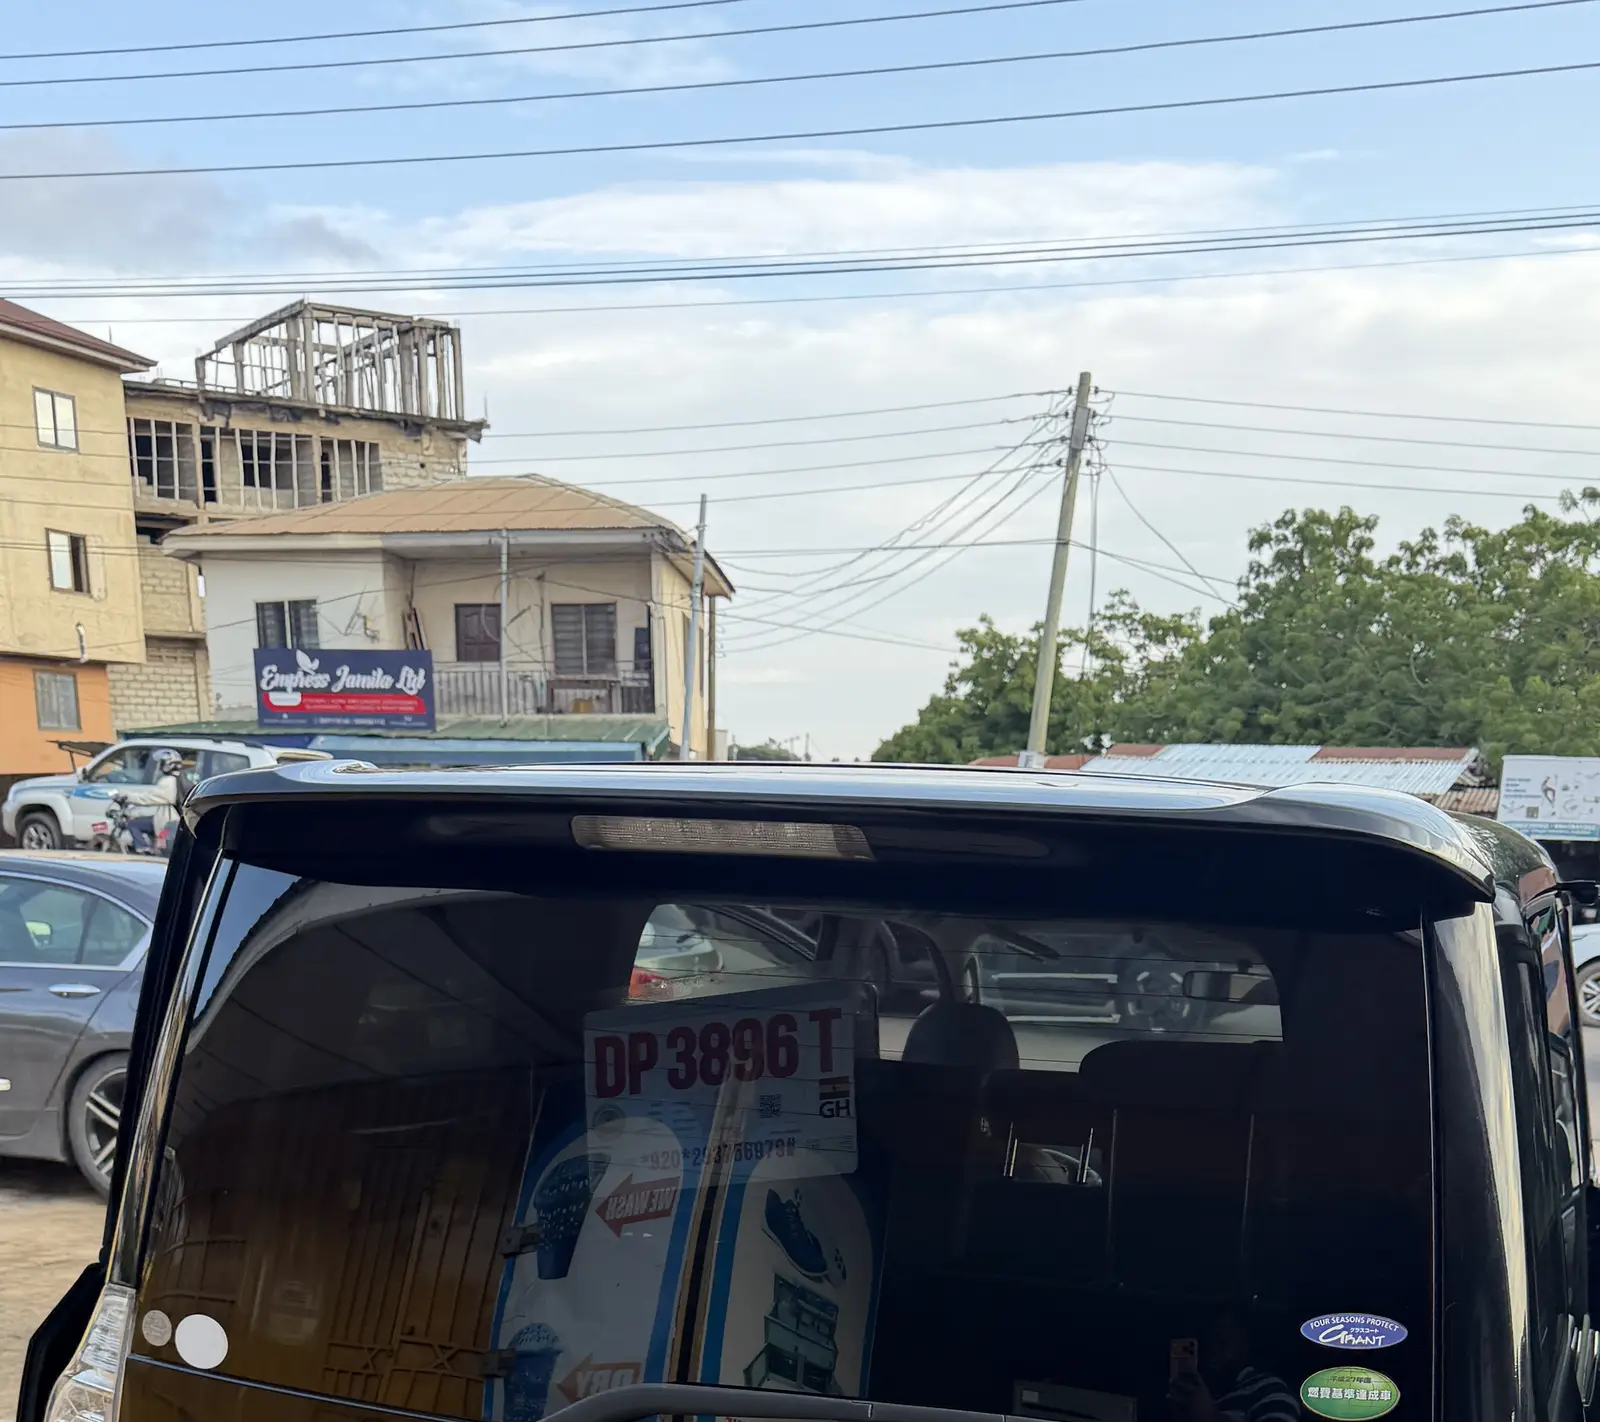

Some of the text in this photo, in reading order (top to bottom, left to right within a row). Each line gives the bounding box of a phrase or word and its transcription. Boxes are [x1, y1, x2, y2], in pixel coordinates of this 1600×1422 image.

[260, 664, 426, 696] Empress Jamila Ltd
[594, 1007, 842, 1098] DP 3896 T
[819, 1099, 850, 1118] GH
[1310, 1316, 1399, 1332] FOUR SEASONS PROTECT
